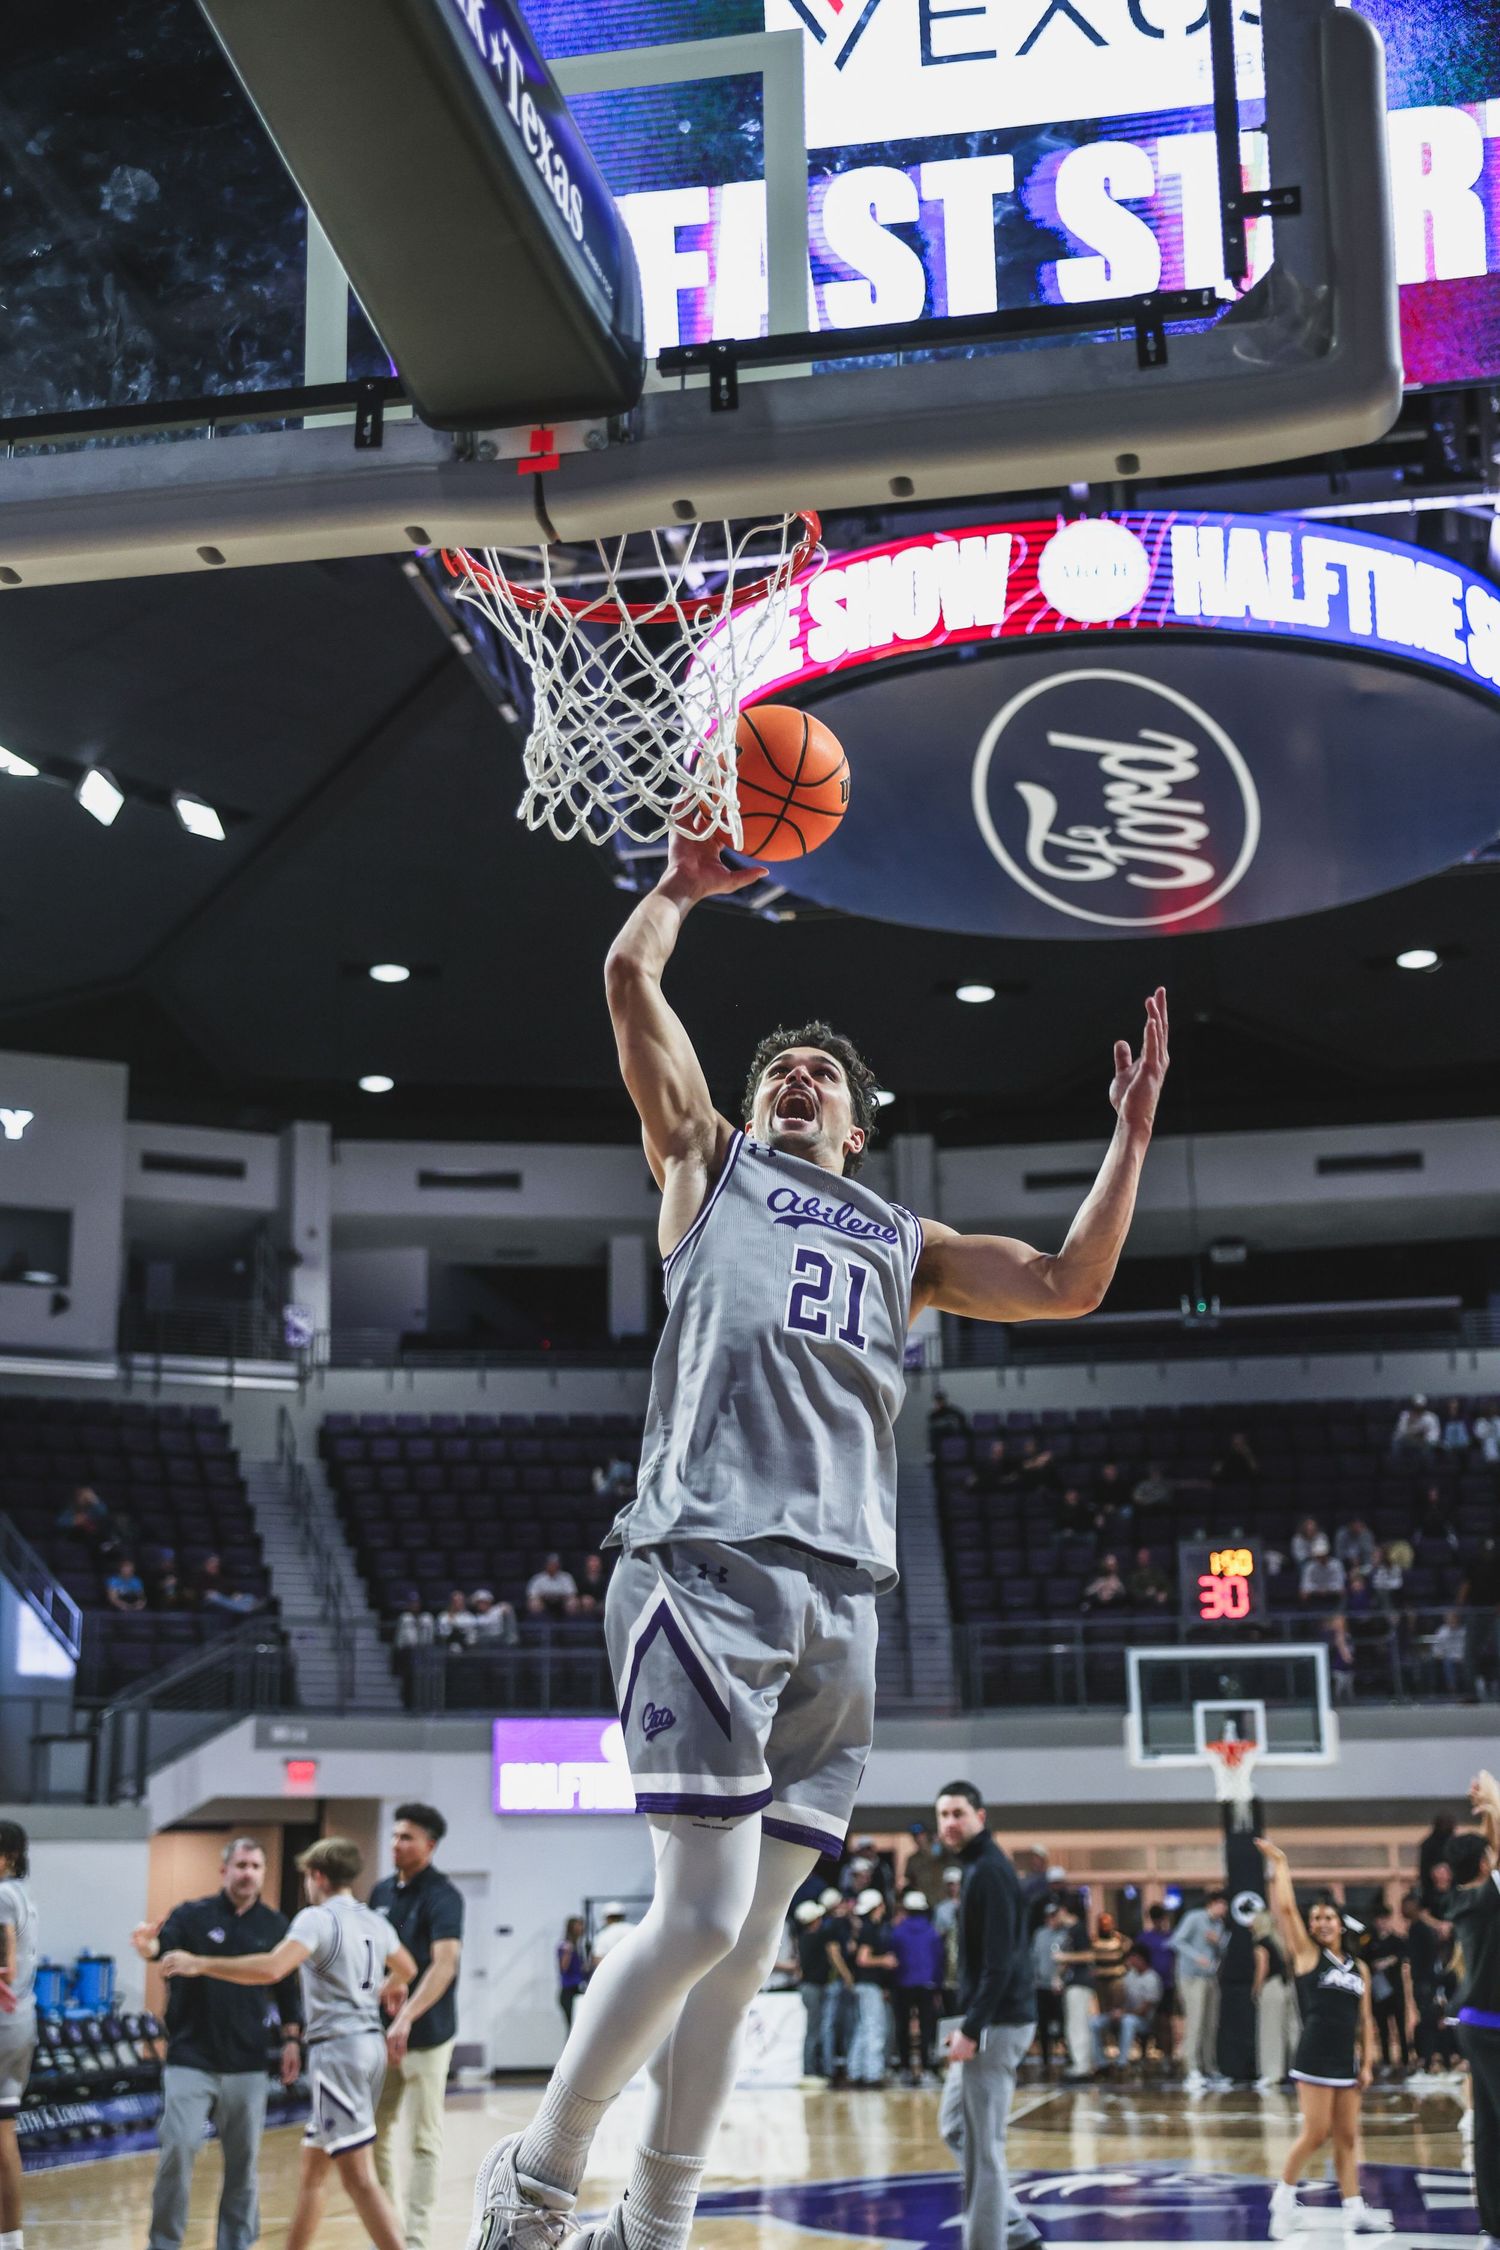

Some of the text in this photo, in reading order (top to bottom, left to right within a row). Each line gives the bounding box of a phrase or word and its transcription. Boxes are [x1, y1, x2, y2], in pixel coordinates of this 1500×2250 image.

[502, 28, 584, 243] Texas
[1015, 729, 1215, 890] Ford
[766, 1187, 898, 1245] Abilene
[783, 1243, 869, 1355] 21
[1198, 1575, 1250, 1619] 30
